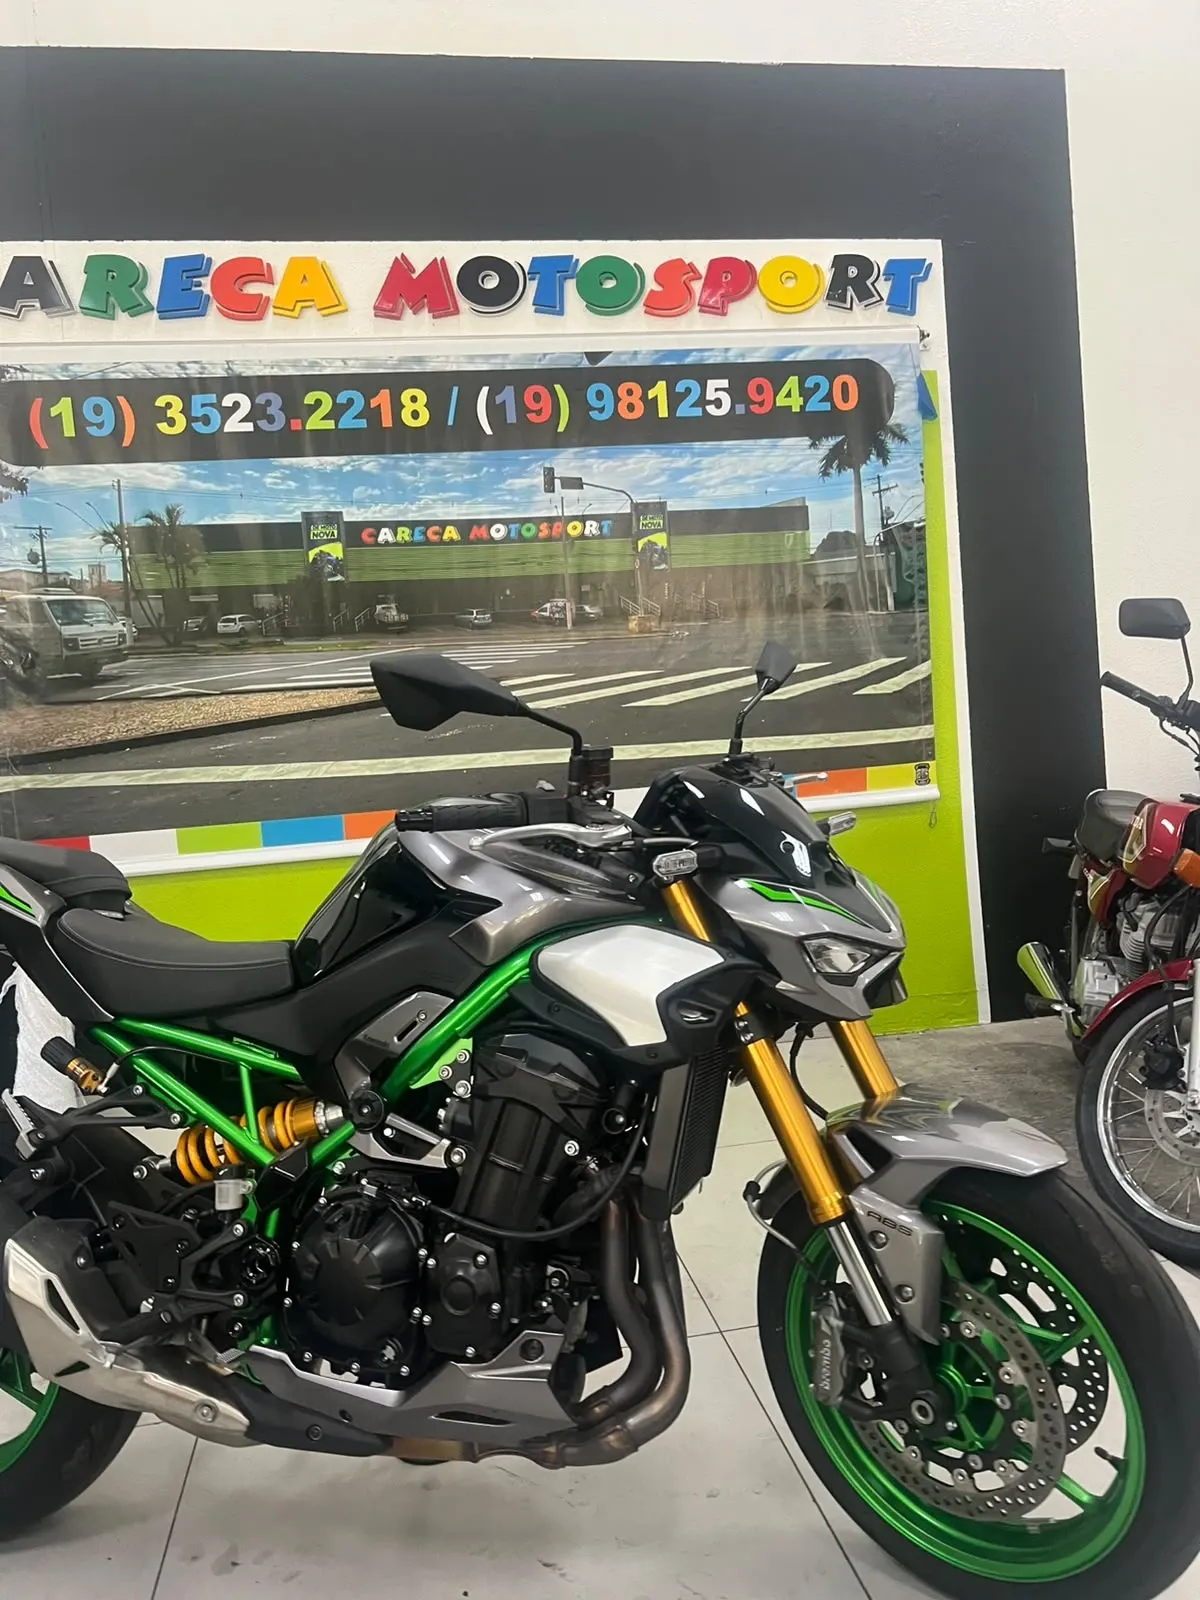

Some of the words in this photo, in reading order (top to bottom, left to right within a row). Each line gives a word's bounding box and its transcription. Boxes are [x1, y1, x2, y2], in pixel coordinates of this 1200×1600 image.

[373, 252, 933, 320] MOTOSPORT
[28, 395, 136, 450] (19)
[154, 388, 430, 436] 3523.2218
[447, 386, 459, 426] /
[476, 384, 571, 435] (19)
[586, 374, 860, 422] 98125.9420
[312, 530, 336, 539] NOVA
[361, 525, 461, 544] CARECA
[469, 520, 613, 541] MOTOSPORT
[641, 521, 662, 529] NOVA
[866, 1210, 914, 1238] ABS
[819, 1338, 832, 1390] brembo
